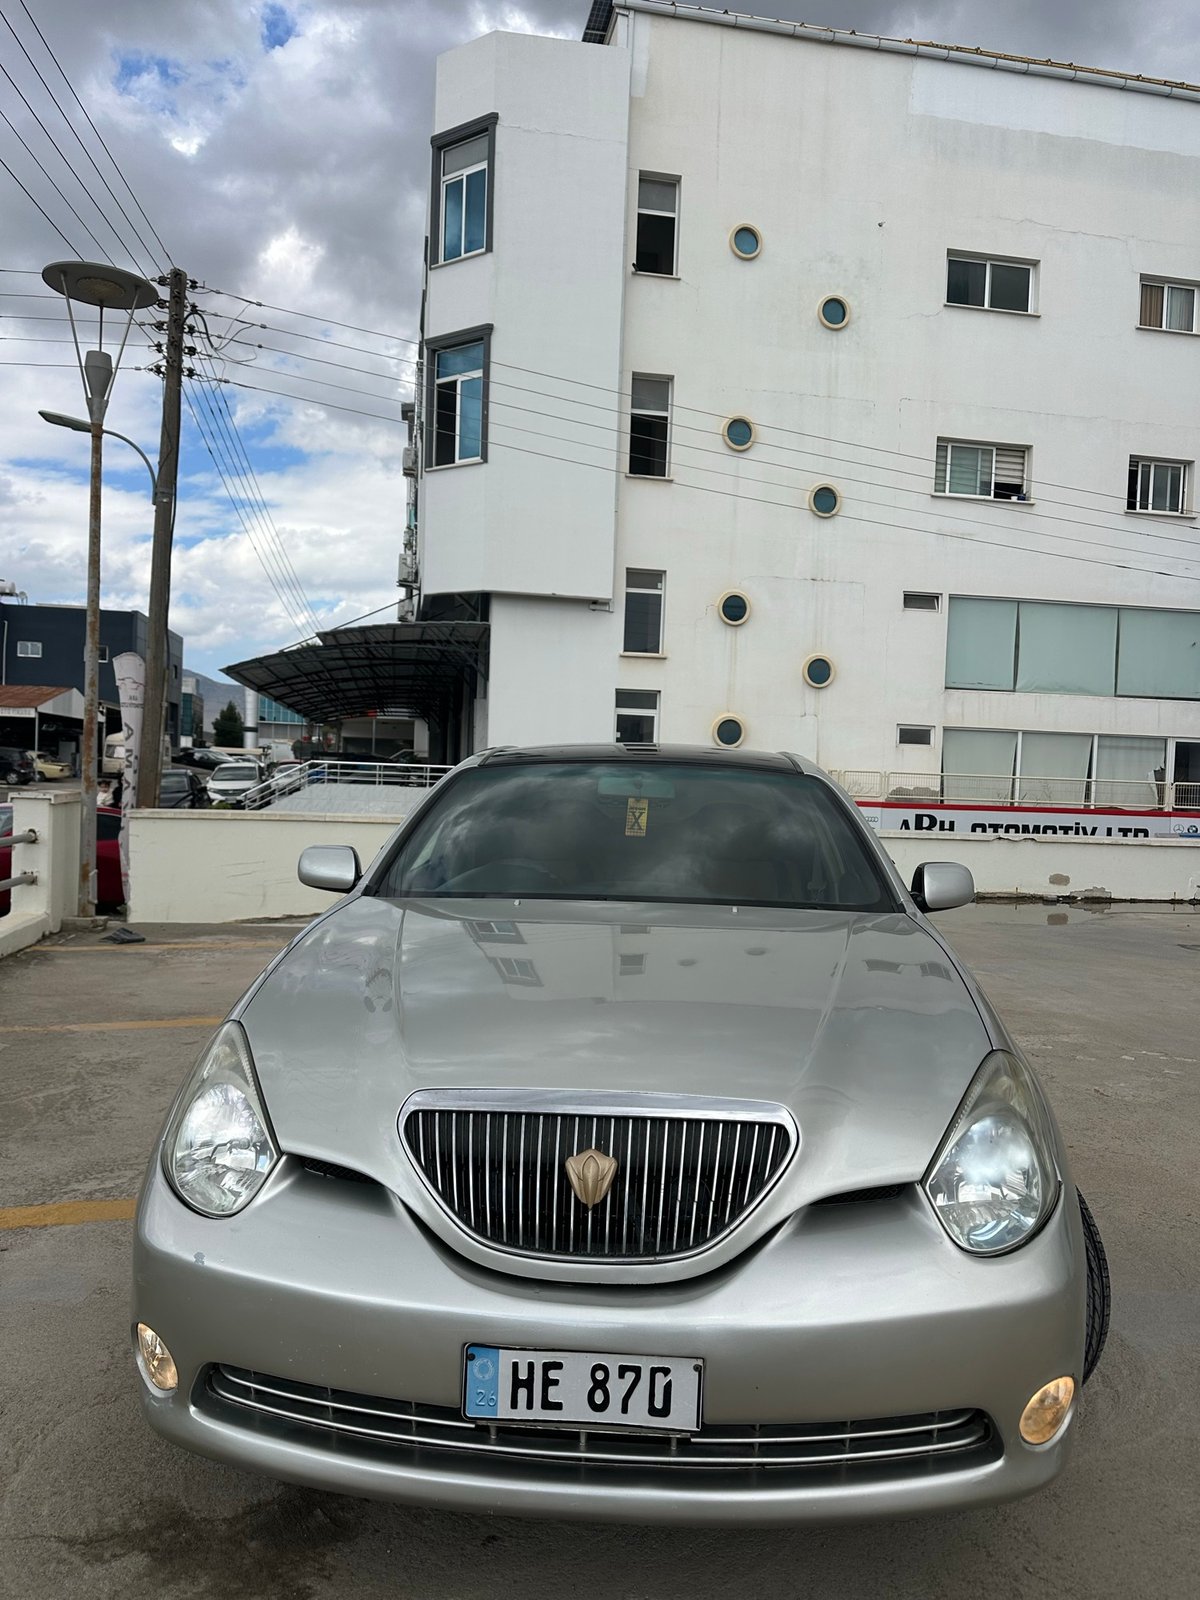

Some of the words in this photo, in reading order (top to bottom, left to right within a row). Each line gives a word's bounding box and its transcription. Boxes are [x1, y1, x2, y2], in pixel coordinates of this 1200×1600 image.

[475, 1389, 497, 1407] 26
[510, 1360, 564, 1411] HE
[587, 1363, 672, 1418] 870
